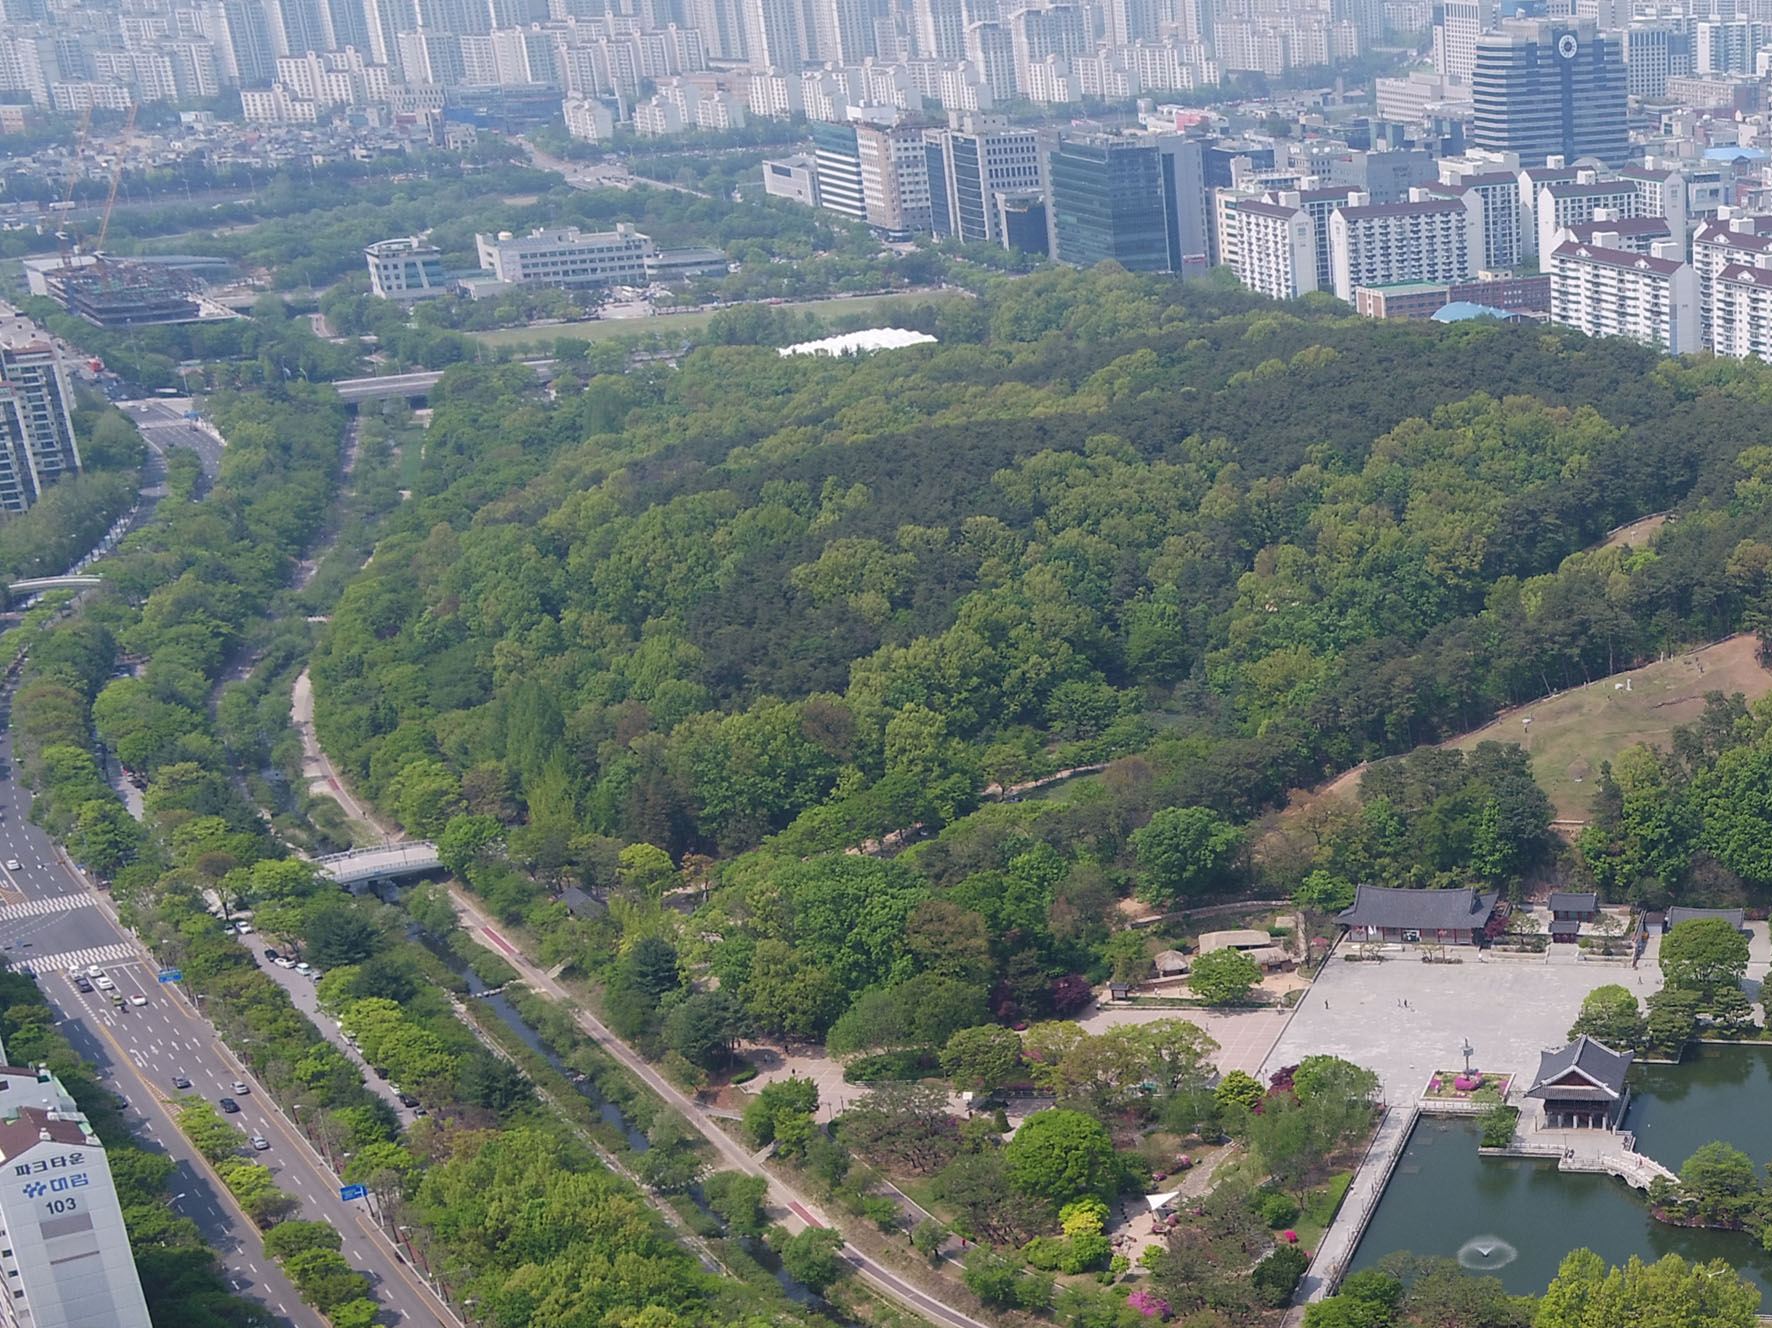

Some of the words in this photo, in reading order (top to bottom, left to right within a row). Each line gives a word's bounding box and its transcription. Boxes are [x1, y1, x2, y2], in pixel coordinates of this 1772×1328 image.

[14, 1152, 85, 1176] 파크타운
[49, 1173, 89, 1192] 대림
[46, 1197, 76, 1215] 103
